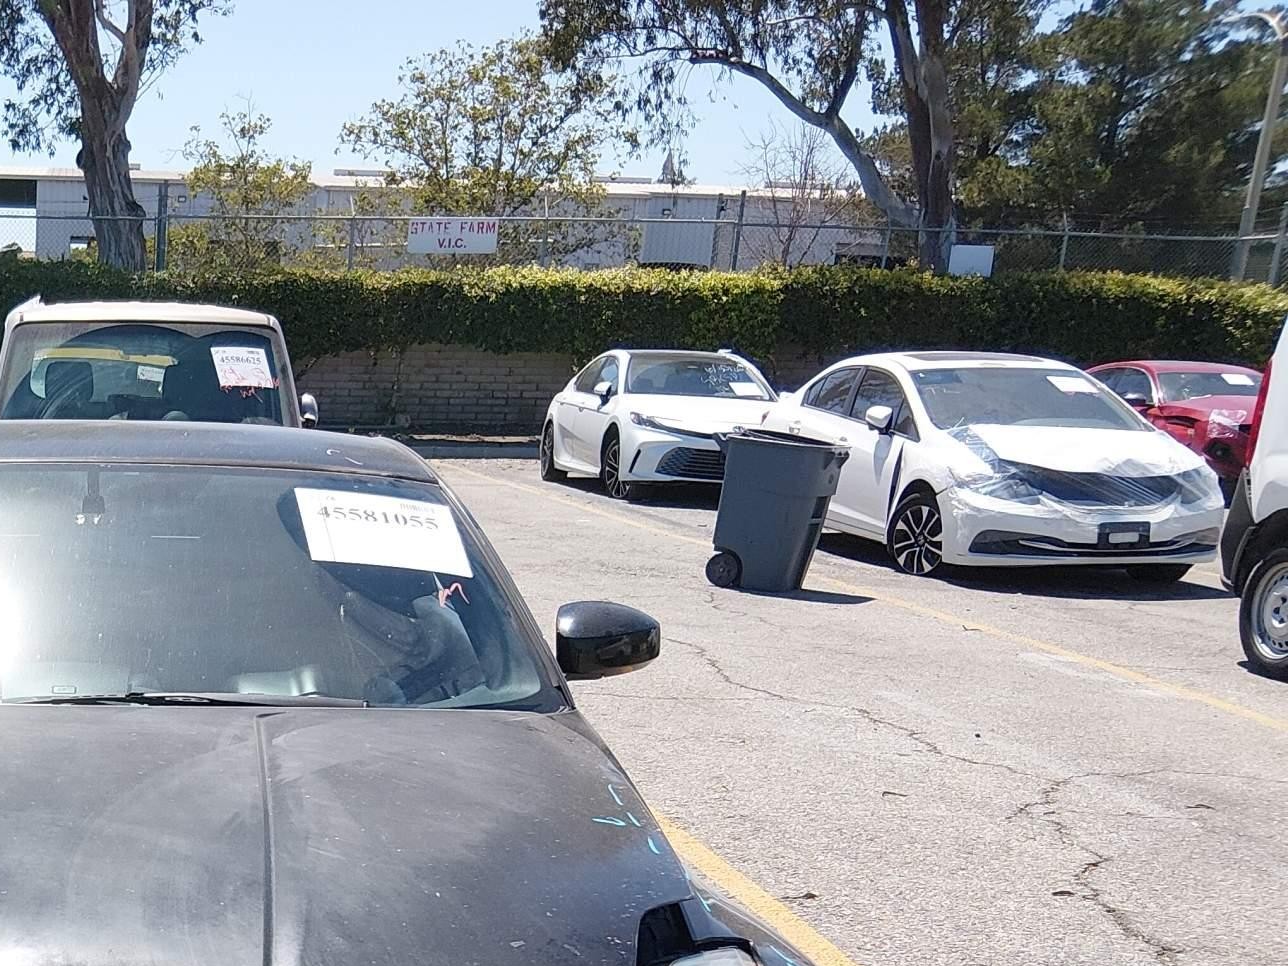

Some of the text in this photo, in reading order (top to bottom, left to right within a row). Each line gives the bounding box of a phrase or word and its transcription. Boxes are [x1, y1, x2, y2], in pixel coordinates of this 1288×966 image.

[411, 221, 496, 234] STATE FARM
[437, 238, 467, 249] V.I.C.
[318, 506, 438, 529] 45581055
